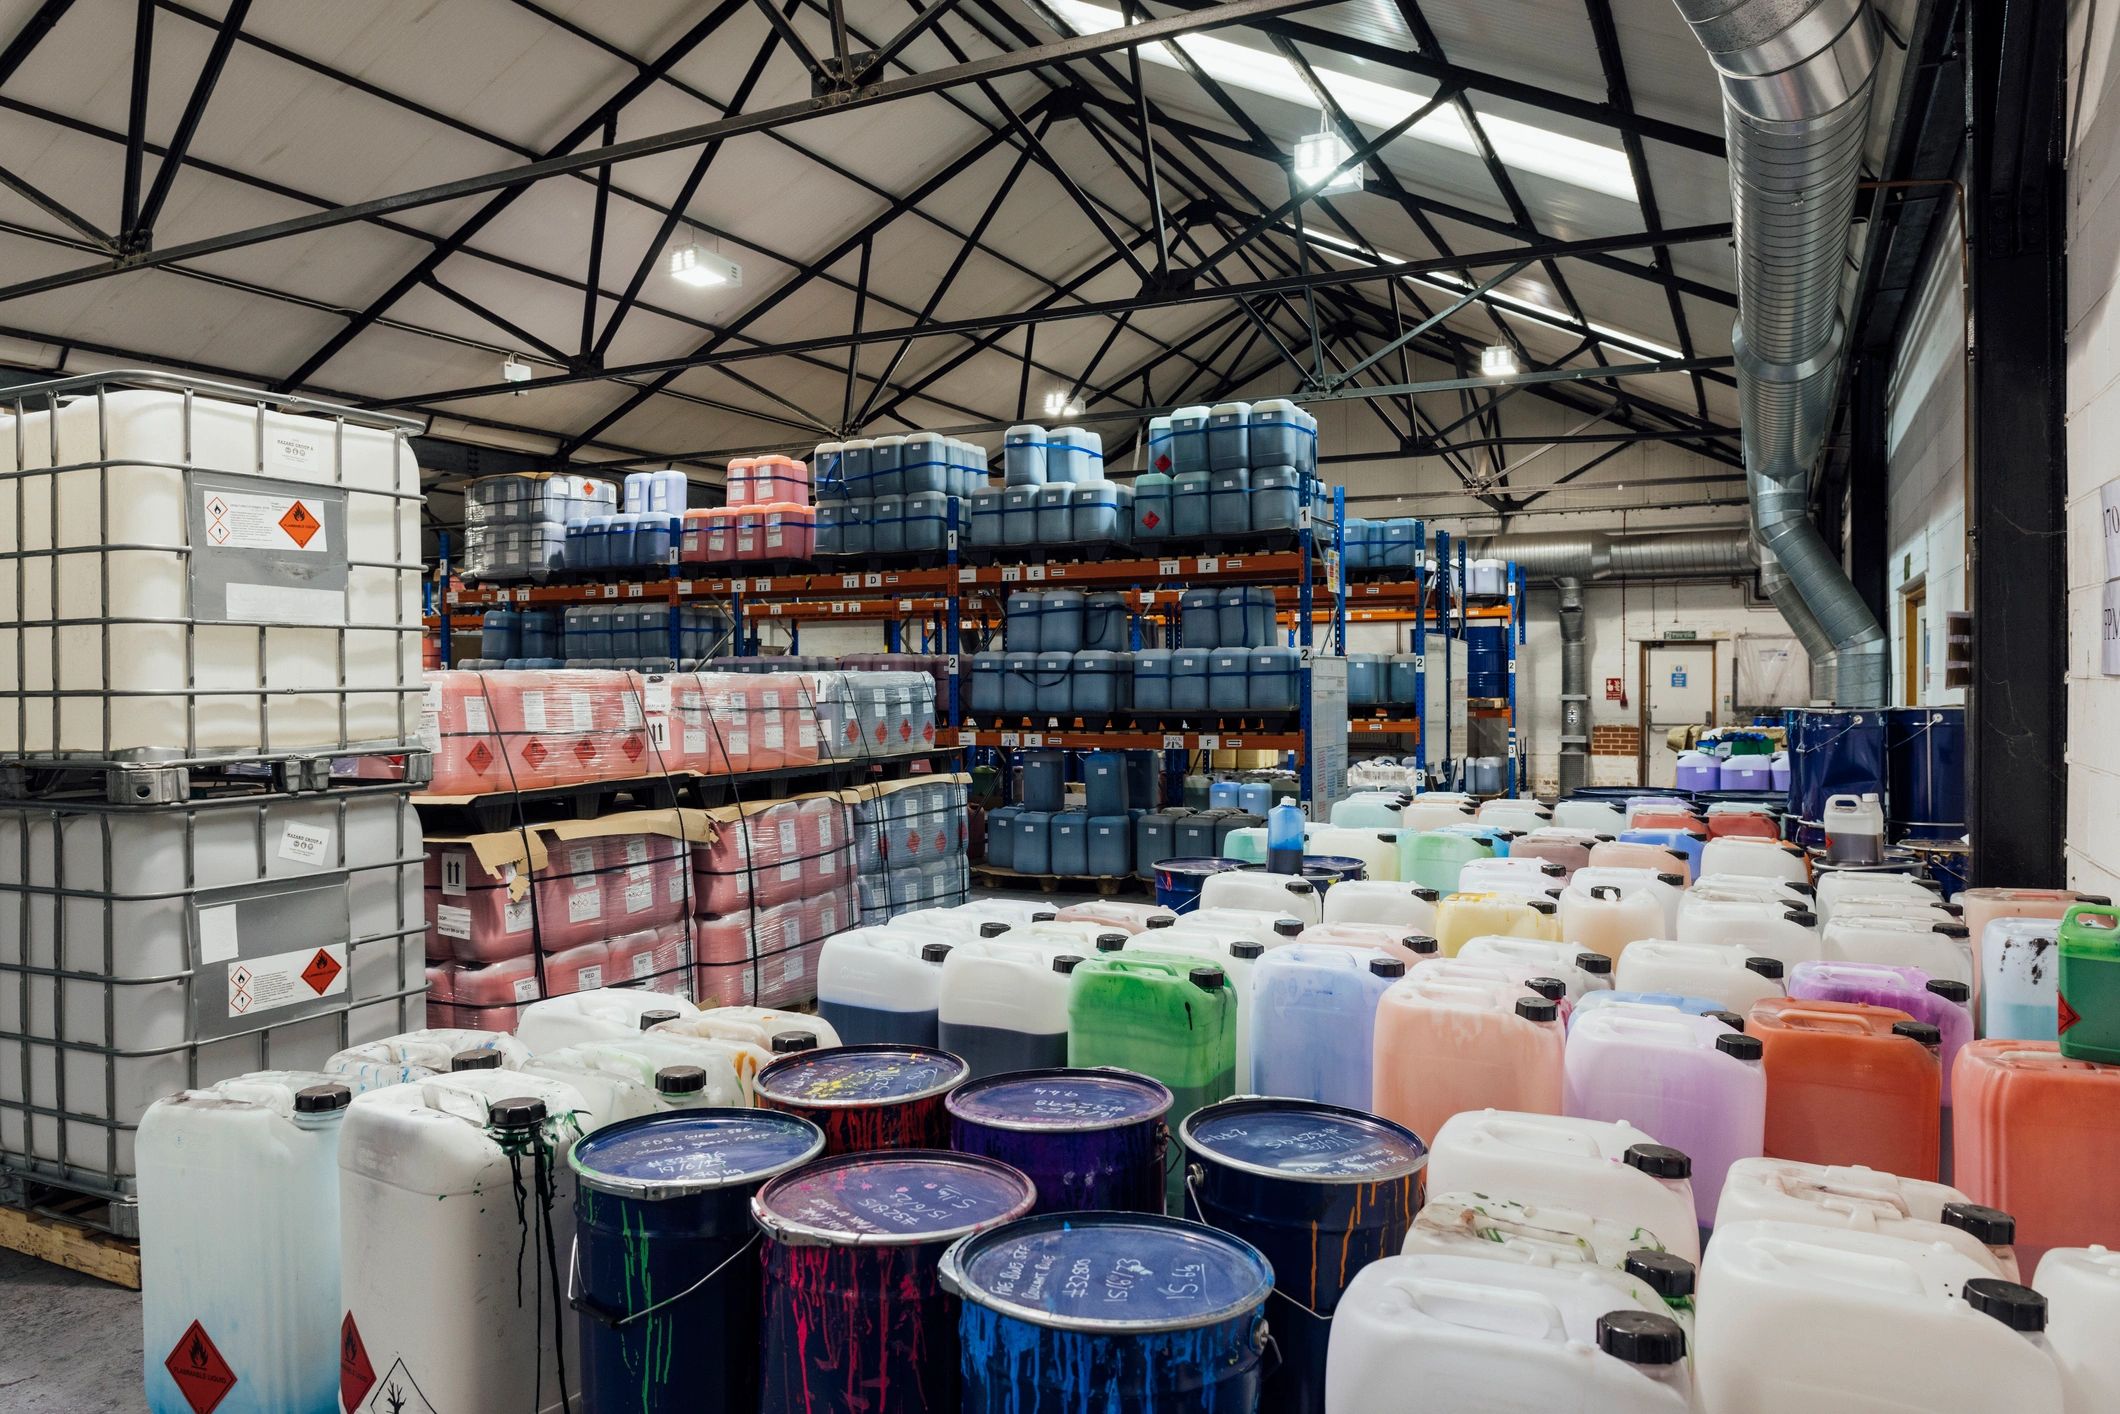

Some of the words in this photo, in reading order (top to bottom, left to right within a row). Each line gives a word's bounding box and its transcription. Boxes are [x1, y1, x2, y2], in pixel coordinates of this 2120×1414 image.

[1301, 510, 1307, 521] 1
[949, 533, 954, 544] 1
[671, 550, 675, 559] 1
[1417, 553, 1422, 562] 1
[870, 576, 877, 584] D
[609, 588, 614, 596] B
[1301, 650, 1309, 661] 2
[670, 661, 675, 671] 2
[950, 657, 956, 668] 2
[1416, 658, 1423, 668] 2
[1031, 737, 1036, 745] E
[1416, 772, 1423, 781] 3
